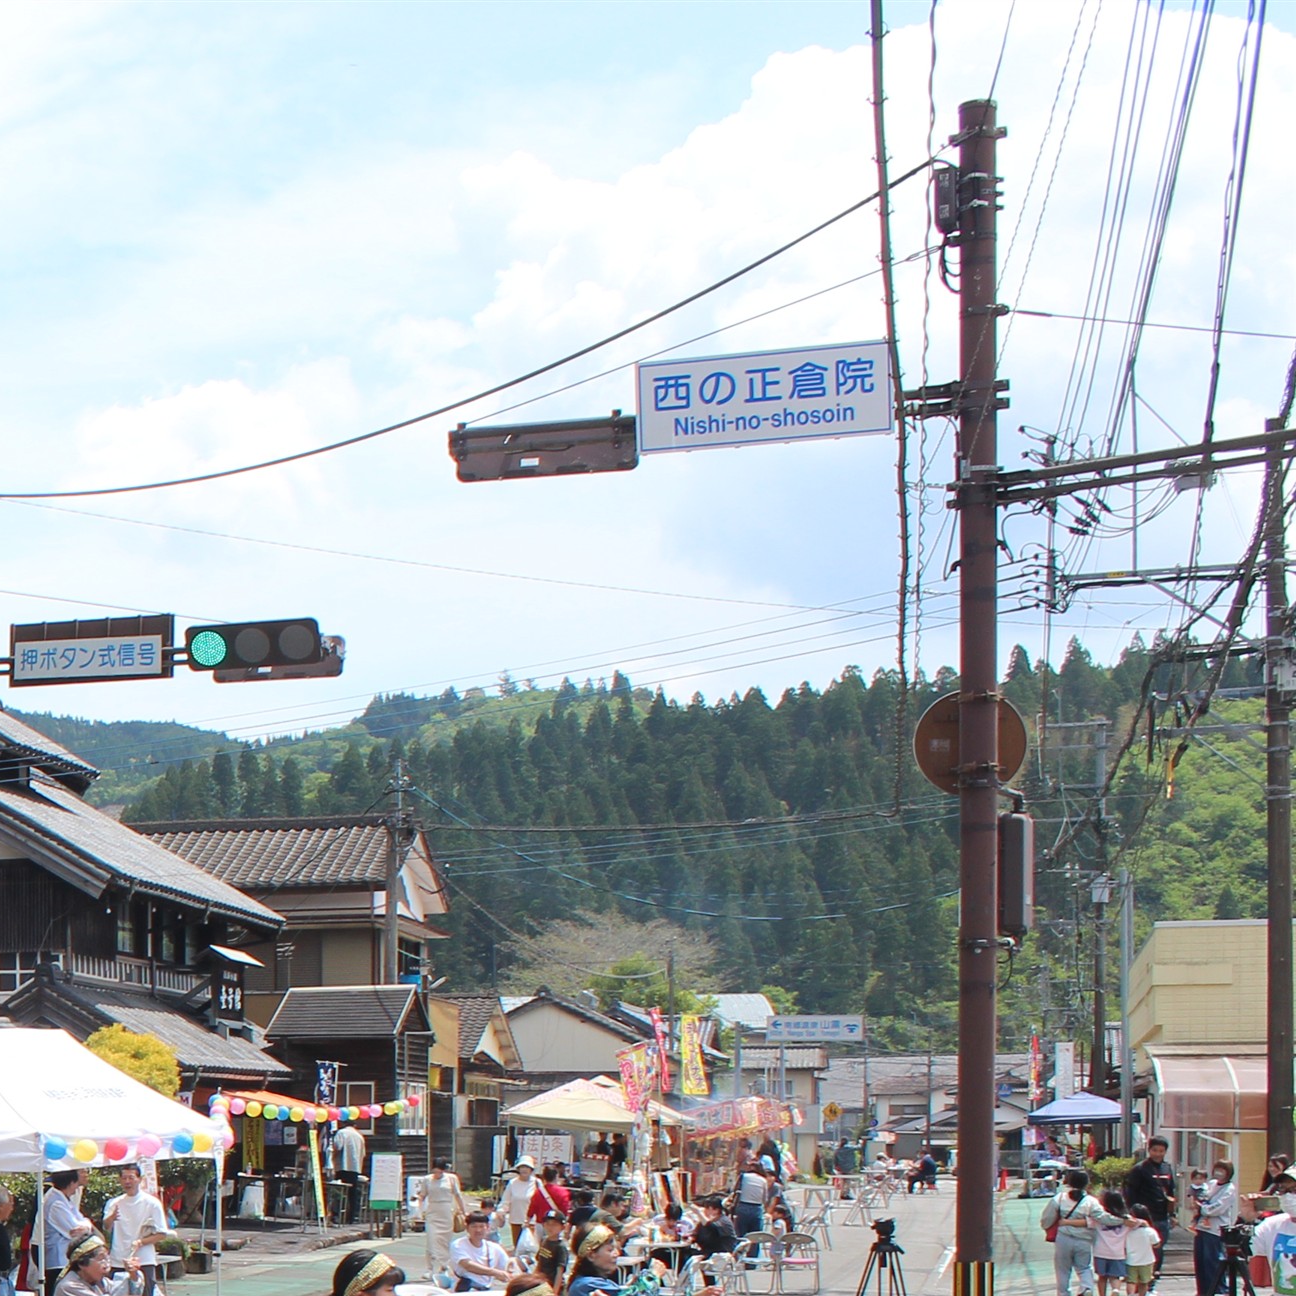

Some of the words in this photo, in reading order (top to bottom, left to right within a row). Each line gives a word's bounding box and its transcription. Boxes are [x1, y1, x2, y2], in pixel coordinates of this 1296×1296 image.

[652, 357, 874, 412] 西の正倉院
[674, 404, 855, 436] Nishi-no-shosoin
[20, 642, 156, 672] 押ボタン式信号
